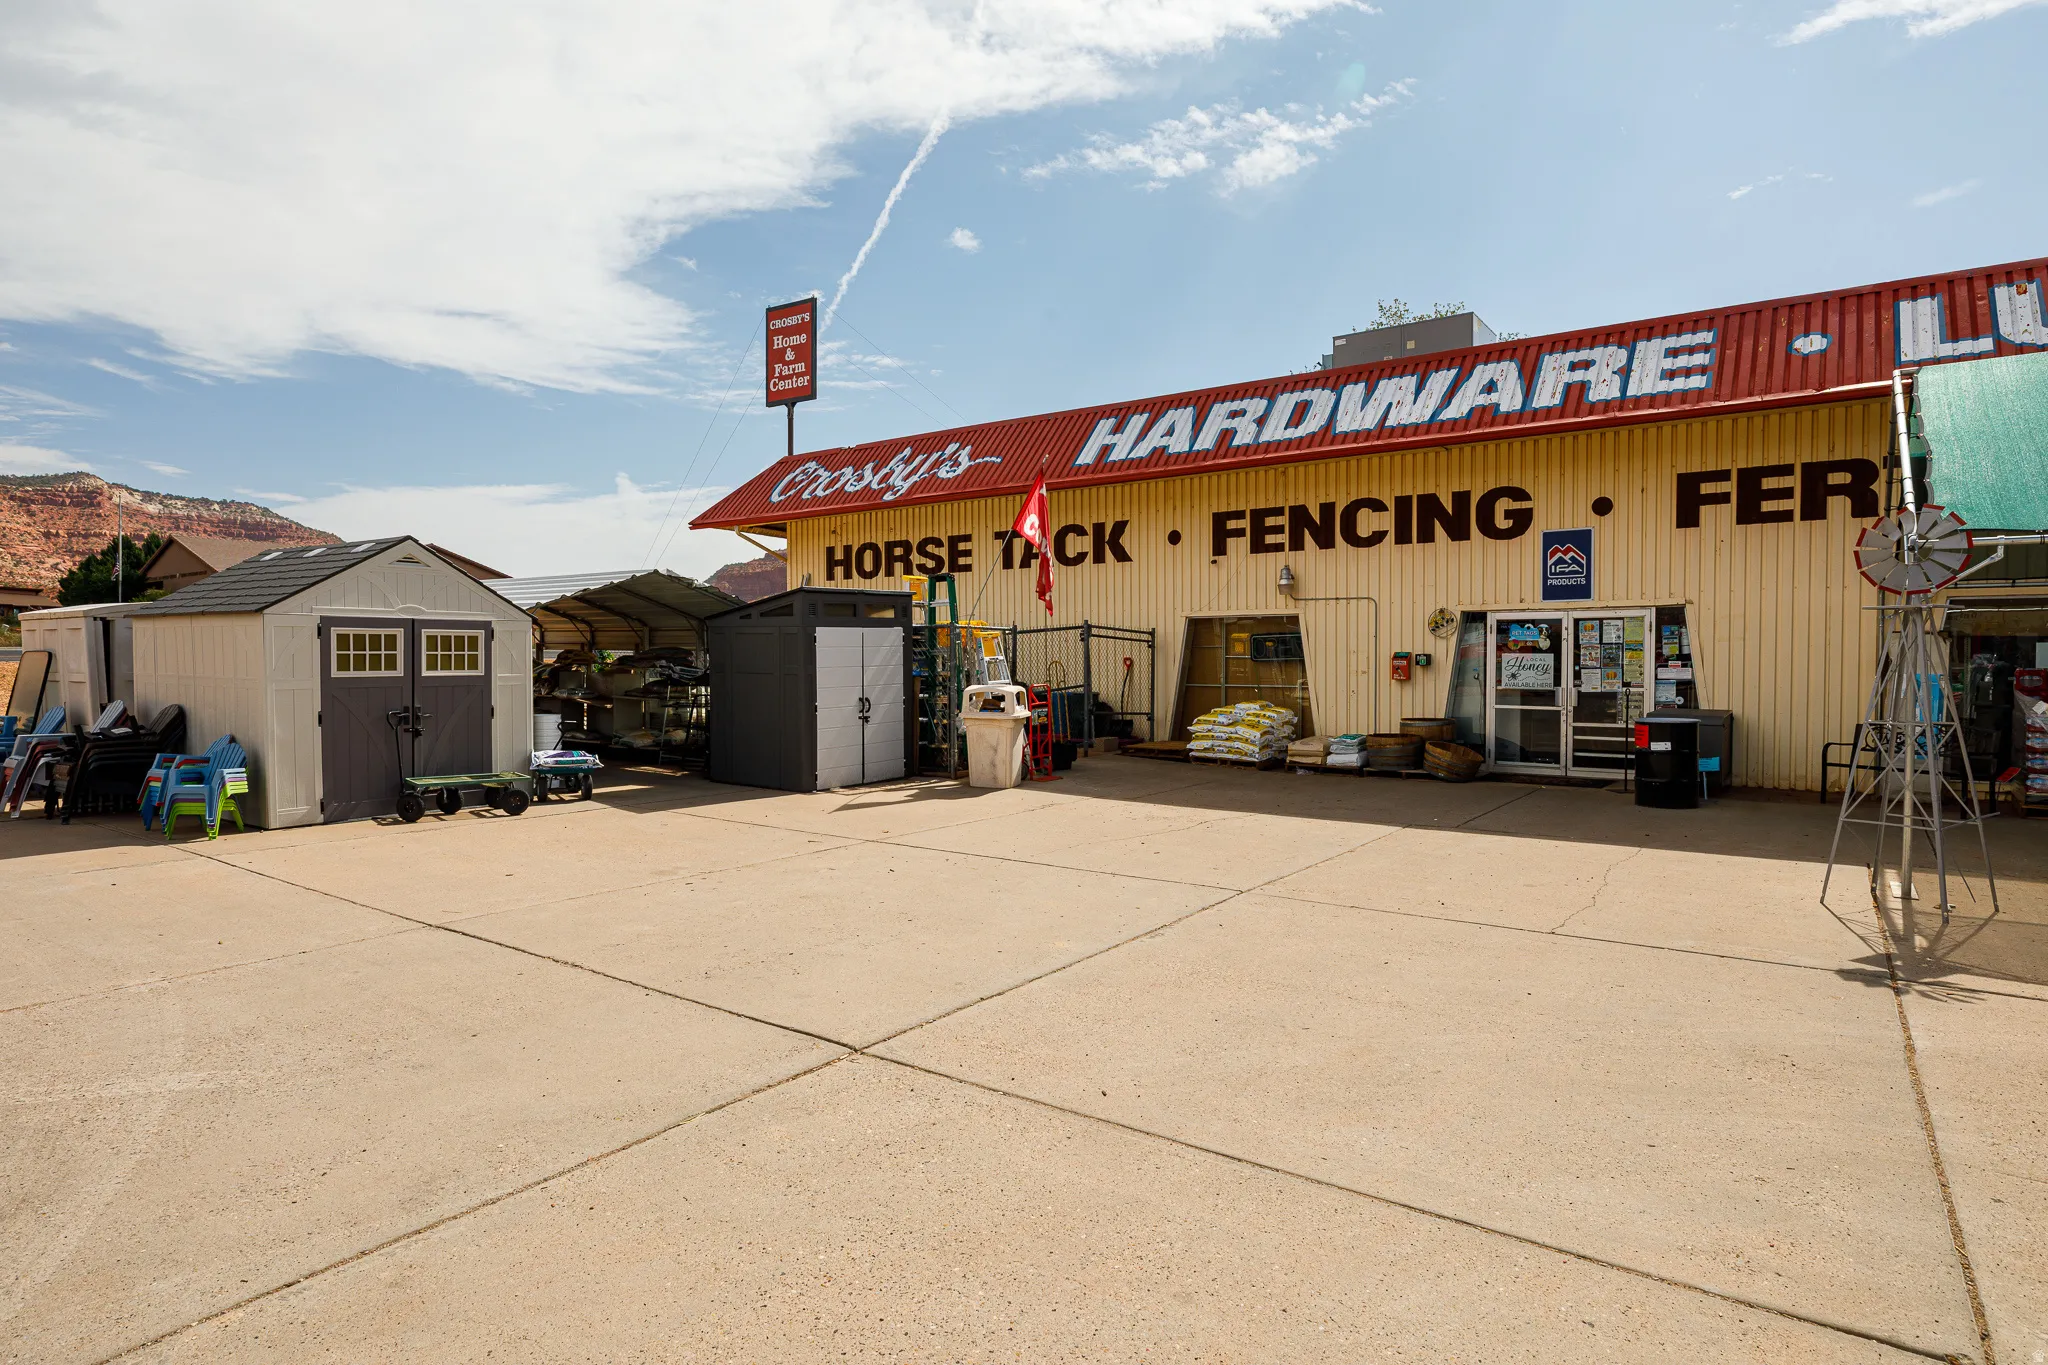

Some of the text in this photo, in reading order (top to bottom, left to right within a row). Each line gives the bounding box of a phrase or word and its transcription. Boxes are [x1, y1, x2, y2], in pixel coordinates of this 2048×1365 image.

[769, 312, 811, 330] CROSBY'S
[772, 333, 808, 350] Home
[784, 347, 796, 361] &
[773, 362, 806, 377] Farm
[769, 375, 811, 392] Center
[1072, 328, 1717, 468] HARDWARE
[769, 442, 1003, 504] Crosby's
[825, 534, 973, 582] HORSE
[1211, 486, 1534, 557] FENCING
[1675, 457, 1902, 530] FER
[1551, 563, 1583, 573] IFA
[1547, 577, 1586, 586] PRODUCTS
[1504, 655, 1552, 677] Honey
